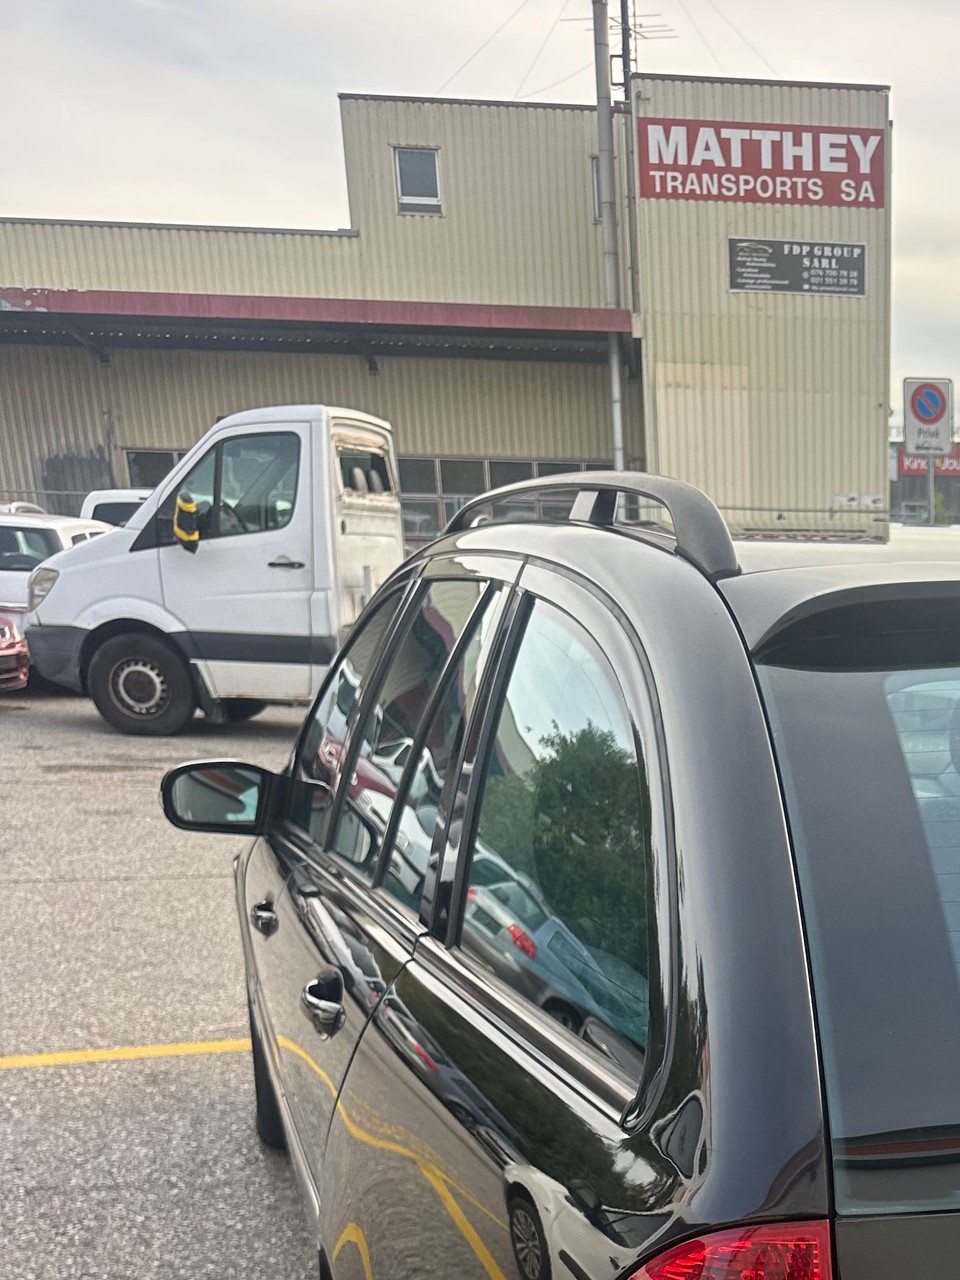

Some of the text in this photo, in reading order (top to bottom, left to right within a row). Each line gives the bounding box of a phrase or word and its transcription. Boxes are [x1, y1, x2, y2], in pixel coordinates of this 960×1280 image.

[647, 124, 882, 174] MATTHEY
[649, 171, 876, 202] TRANSPORTS SA
[783, 244, 862, 258] FDP GROUP
[802, 257, 840, 269] SARL
